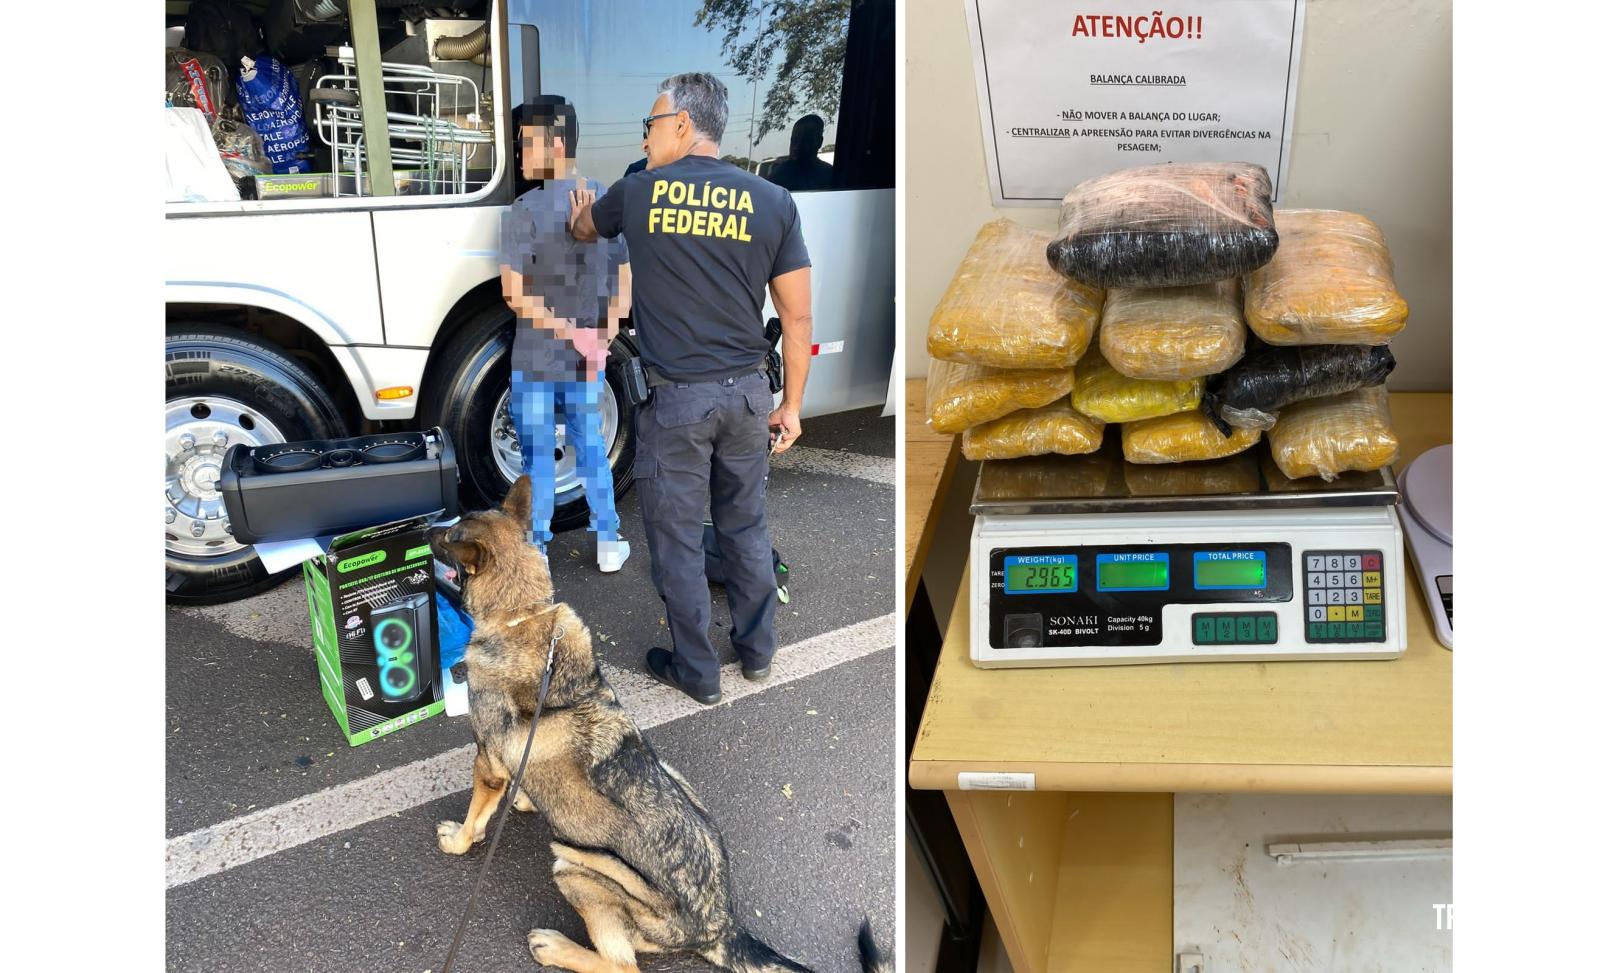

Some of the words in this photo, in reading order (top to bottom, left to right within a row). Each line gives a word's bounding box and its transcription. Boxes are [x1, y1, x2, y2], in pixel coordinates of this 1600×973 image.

[1072, 11, 1202, 43] ATENÇÃO!!
[1090, 74, 1133, 85] BALANÇA
[1135, 75, 1186, 85] CALIBRADA
[1062, 109, 1082, 120] NÃO
[1085, 111, 1118, 120] MOVER
[1120, 112, 1127, 120] A
[1129, 111, 1170, 122] BALANÇA
[1172, 112, 1186, 120] DO
[1188, 113, 1221, 122] LUGAR;
[1012, 128, 1070, 137] CENTRALIZAR
[1072, 129, 1079, 137] A
[1081, 128, 1133, 137] APREENSÃO
[1135, 130, 1158, 138] PARA
[1161, 130, 1190, 138] EVITAR
[1193, 129, 1256, 139] DIVERGÊNCIAS
[1258, 131, 1271, 139] NA
[1117, 143, 1161, 152] PESAGEM;
[265, 180, 318, 193] Ecopower
[651, 180, 754, 214] POLÍCIA
[648, 208, 752, 242] FEDERAL
[344, 554, 378, 569] Ecopower
[1017, 556, 1065, 565] WEIGHT(kg)
[1313, 559, 1319, 568] 7
[1331, 559, 1338, 568] 8
[1349, 559, 1356, 568] 9
[1026, 567, 1073, 588] 2.965
[1313, 576, 1320, 585] 4
[1332, 576, 1339, 585] 5
[1350, 575, 1357, 584] 6
[1315, 593, 1320, 602] 1
[1332, 592, 1339, 602] 2
[1351, 592, 1358, 602] 3
[1315, 609, 1321, 619] 0
[1050, 616, 1098, 626] SONAKI
